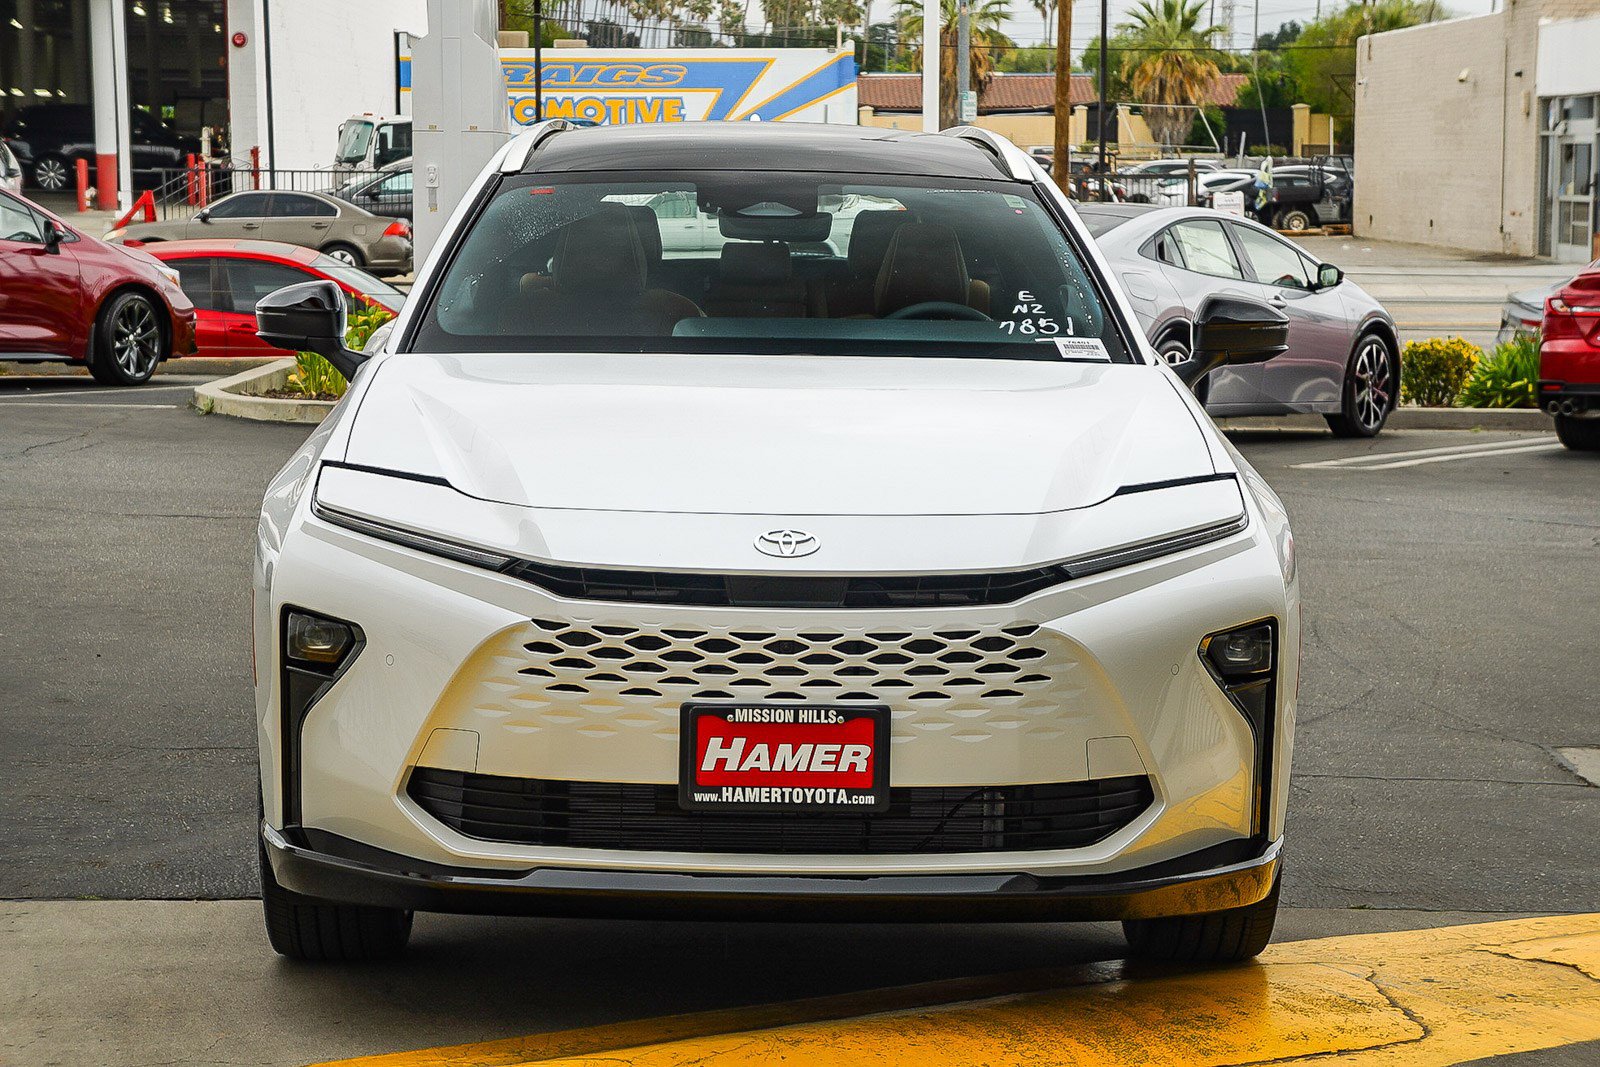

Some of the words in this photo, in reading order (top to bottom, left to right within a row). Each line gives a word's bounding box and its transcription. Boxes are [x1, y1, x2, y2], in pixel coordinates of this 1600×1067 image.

[508, 96, 687, 126] OMOTIVE
[1018, 290, 1036, 302] E
[735, 708, 794, 723] MISSION
[798, 710, 837, 724] HILLS
[701, 737, 871, 773] HAMER
[694, 787, 875, 805] www.HAMERTOYOTA.com
